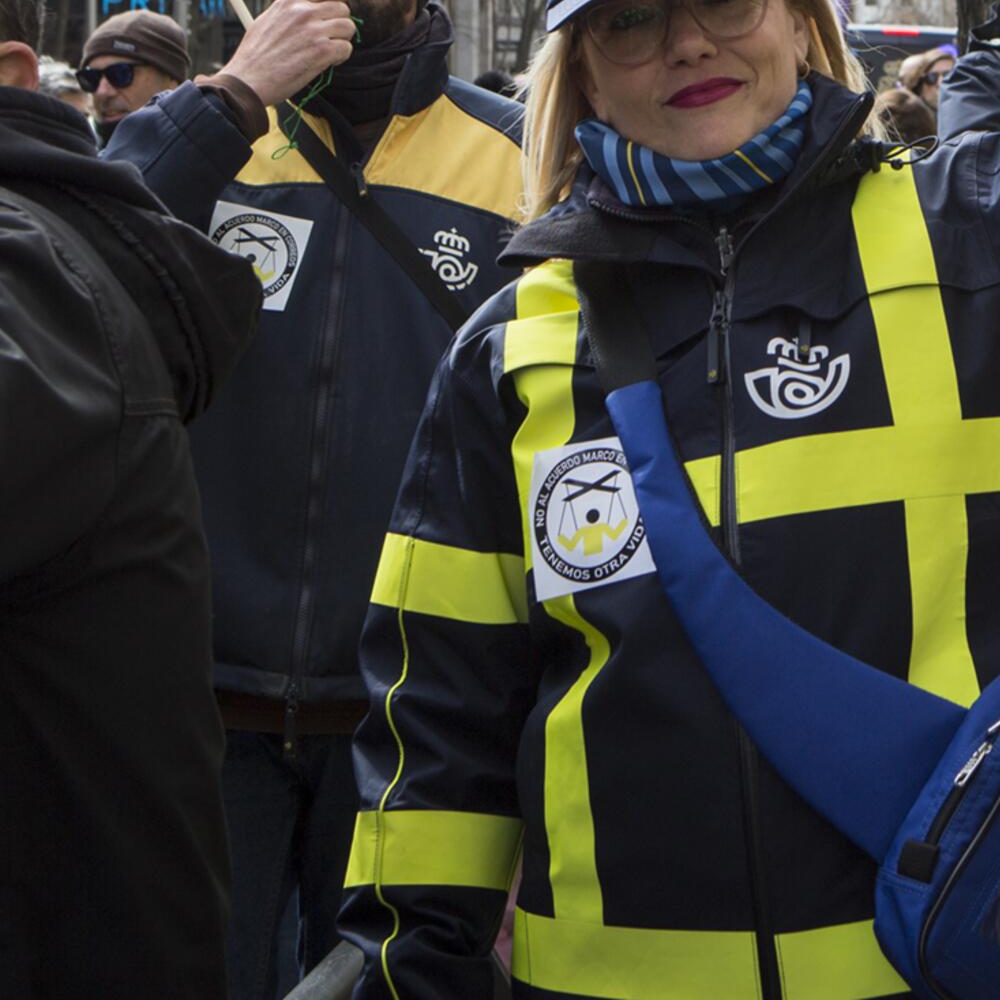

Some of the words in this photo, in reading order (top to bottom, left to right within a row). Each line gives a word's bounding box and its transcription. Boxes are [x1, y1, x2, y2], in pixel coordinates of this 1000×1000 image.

[268, 272, 290, 294] VIDA
[583, 450, 615, 463] MARCO
[543, 456, 582, 489] ACUERDO
[537, 491, 550, 508] AL
[536, 509, 546, 528] NO
[540, 536, 591, 581] TENEMOS
[594, 553, 629, 578] OTRA
[627, 517, 645, 551] VID
